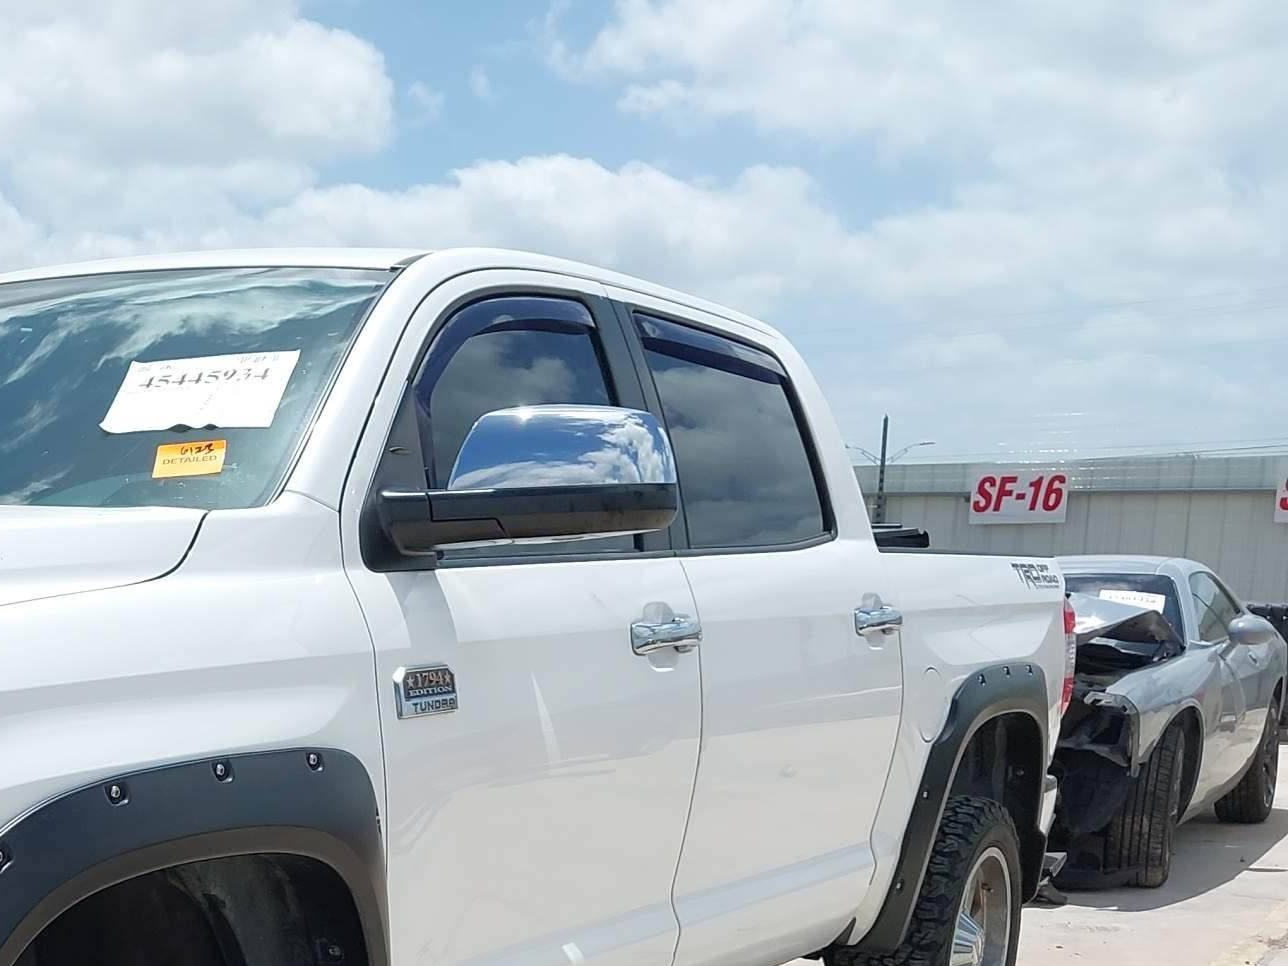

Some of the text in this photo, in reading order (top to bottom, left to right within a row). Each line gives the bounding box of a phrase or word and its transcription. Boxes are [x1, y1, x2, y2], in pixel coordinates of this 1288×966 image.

[139, 367, 270, 388] 45445934
[163, 455, 217, 465] DETAILED
[972, 474, 1066, 513] SF-16
[416, 671, 444, 687] 1794
[408, 686, 452, 697] EDITION
[411, 698, 455, 713] TUNDRA
